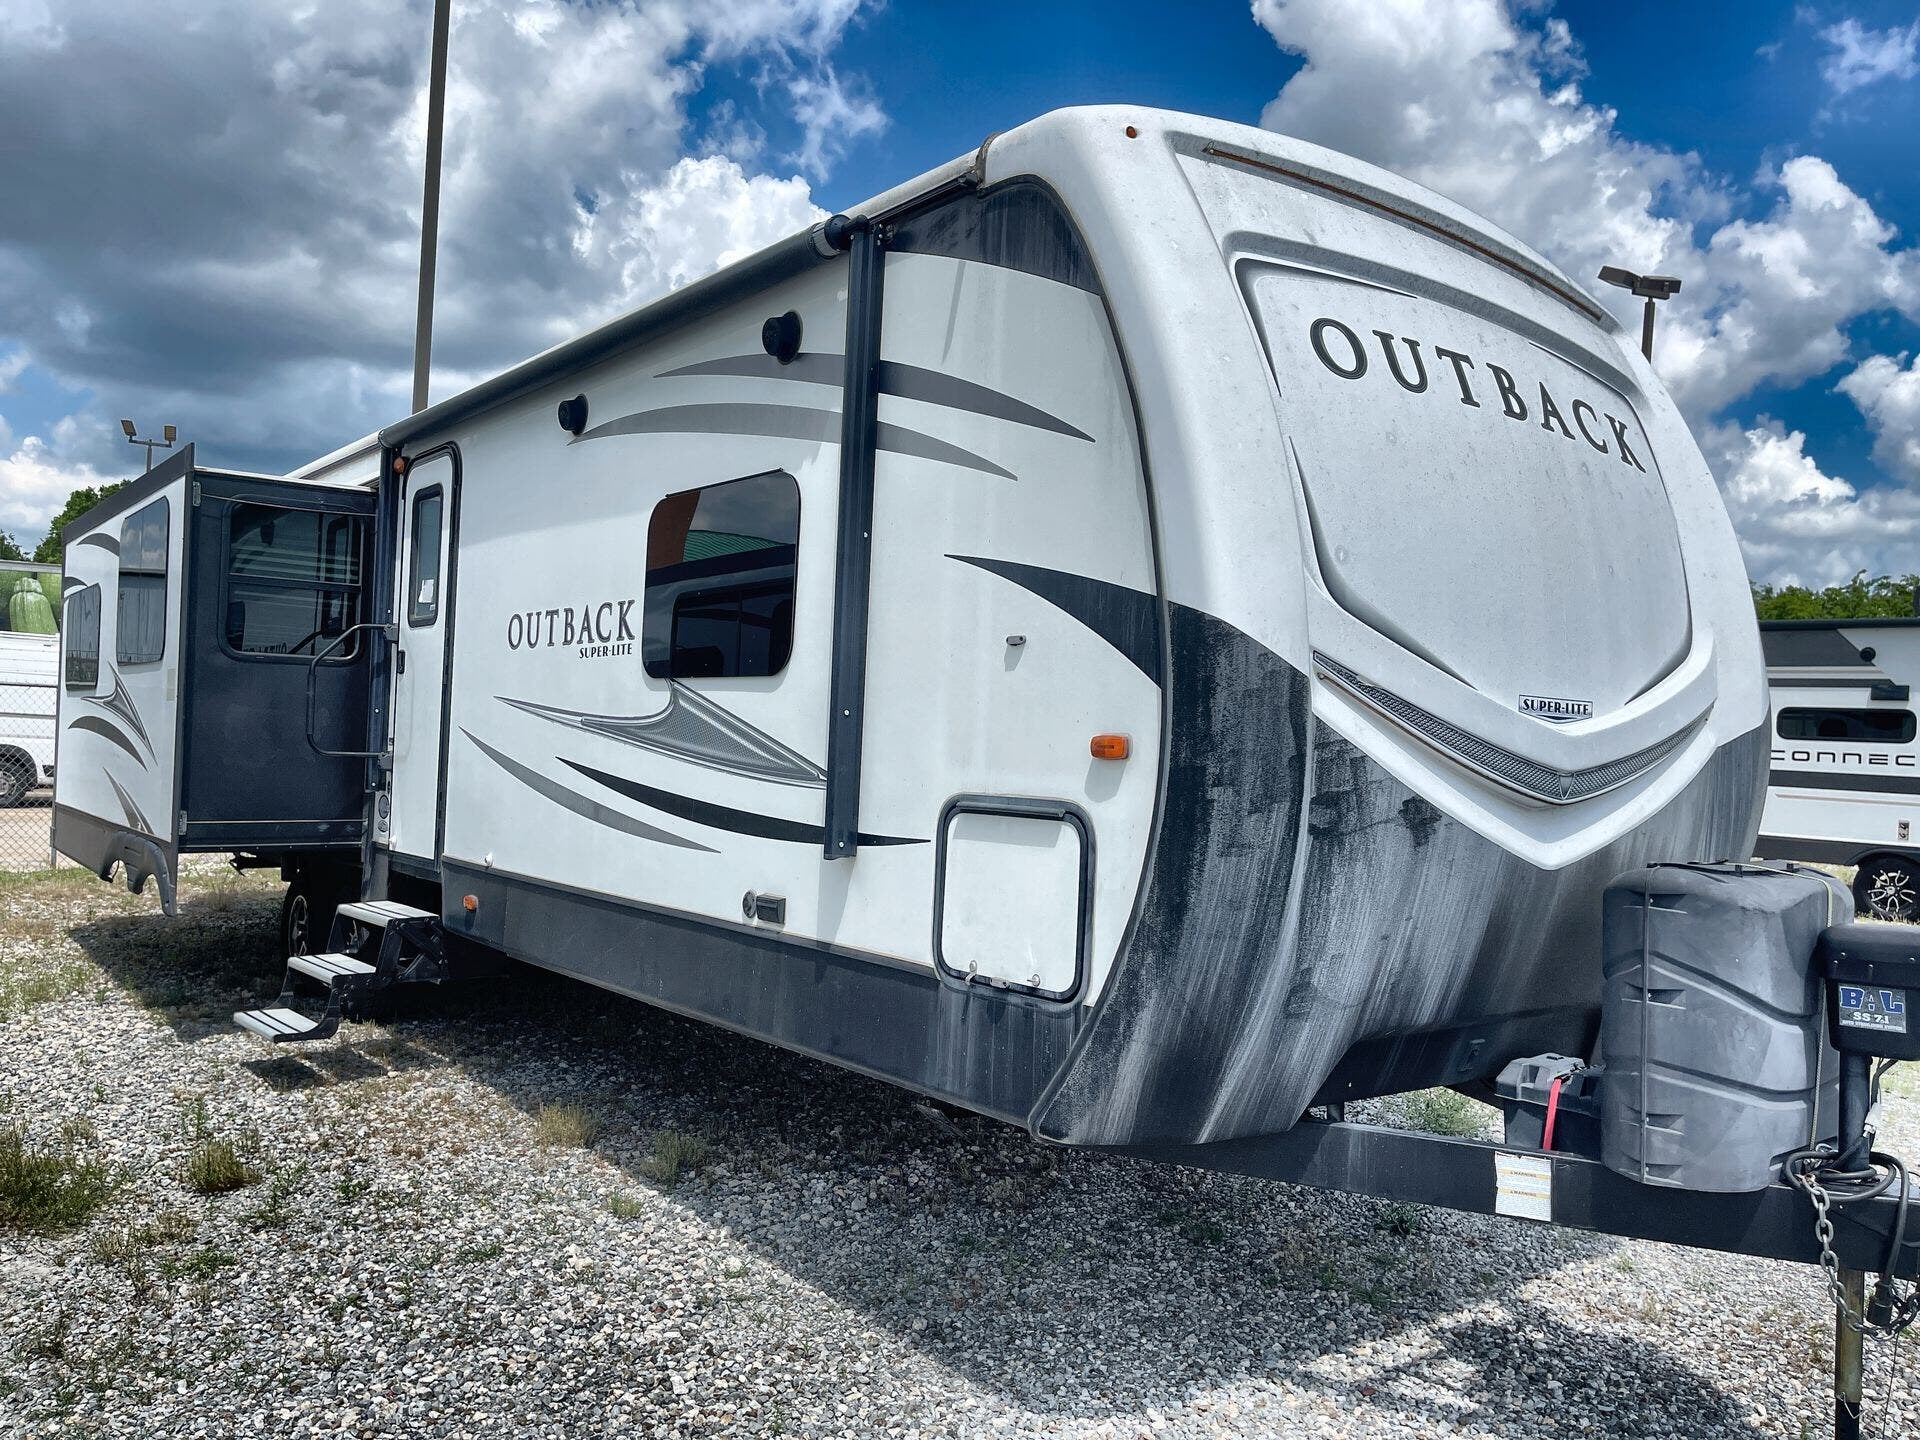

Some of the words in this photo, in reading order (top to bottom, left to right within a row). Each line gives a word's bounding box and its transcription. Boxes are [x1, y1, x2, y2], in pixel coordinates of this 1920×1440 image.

[1310, 317, 1646, 473] OUTBACK
[508, 600, 635, 650] OUTBACK
[579, 643, 633, 659] SUPER-LITE
[1522, 698, 1589, 715] SUPER-LITE
[1853, 1011, 1871, 1022] SS
